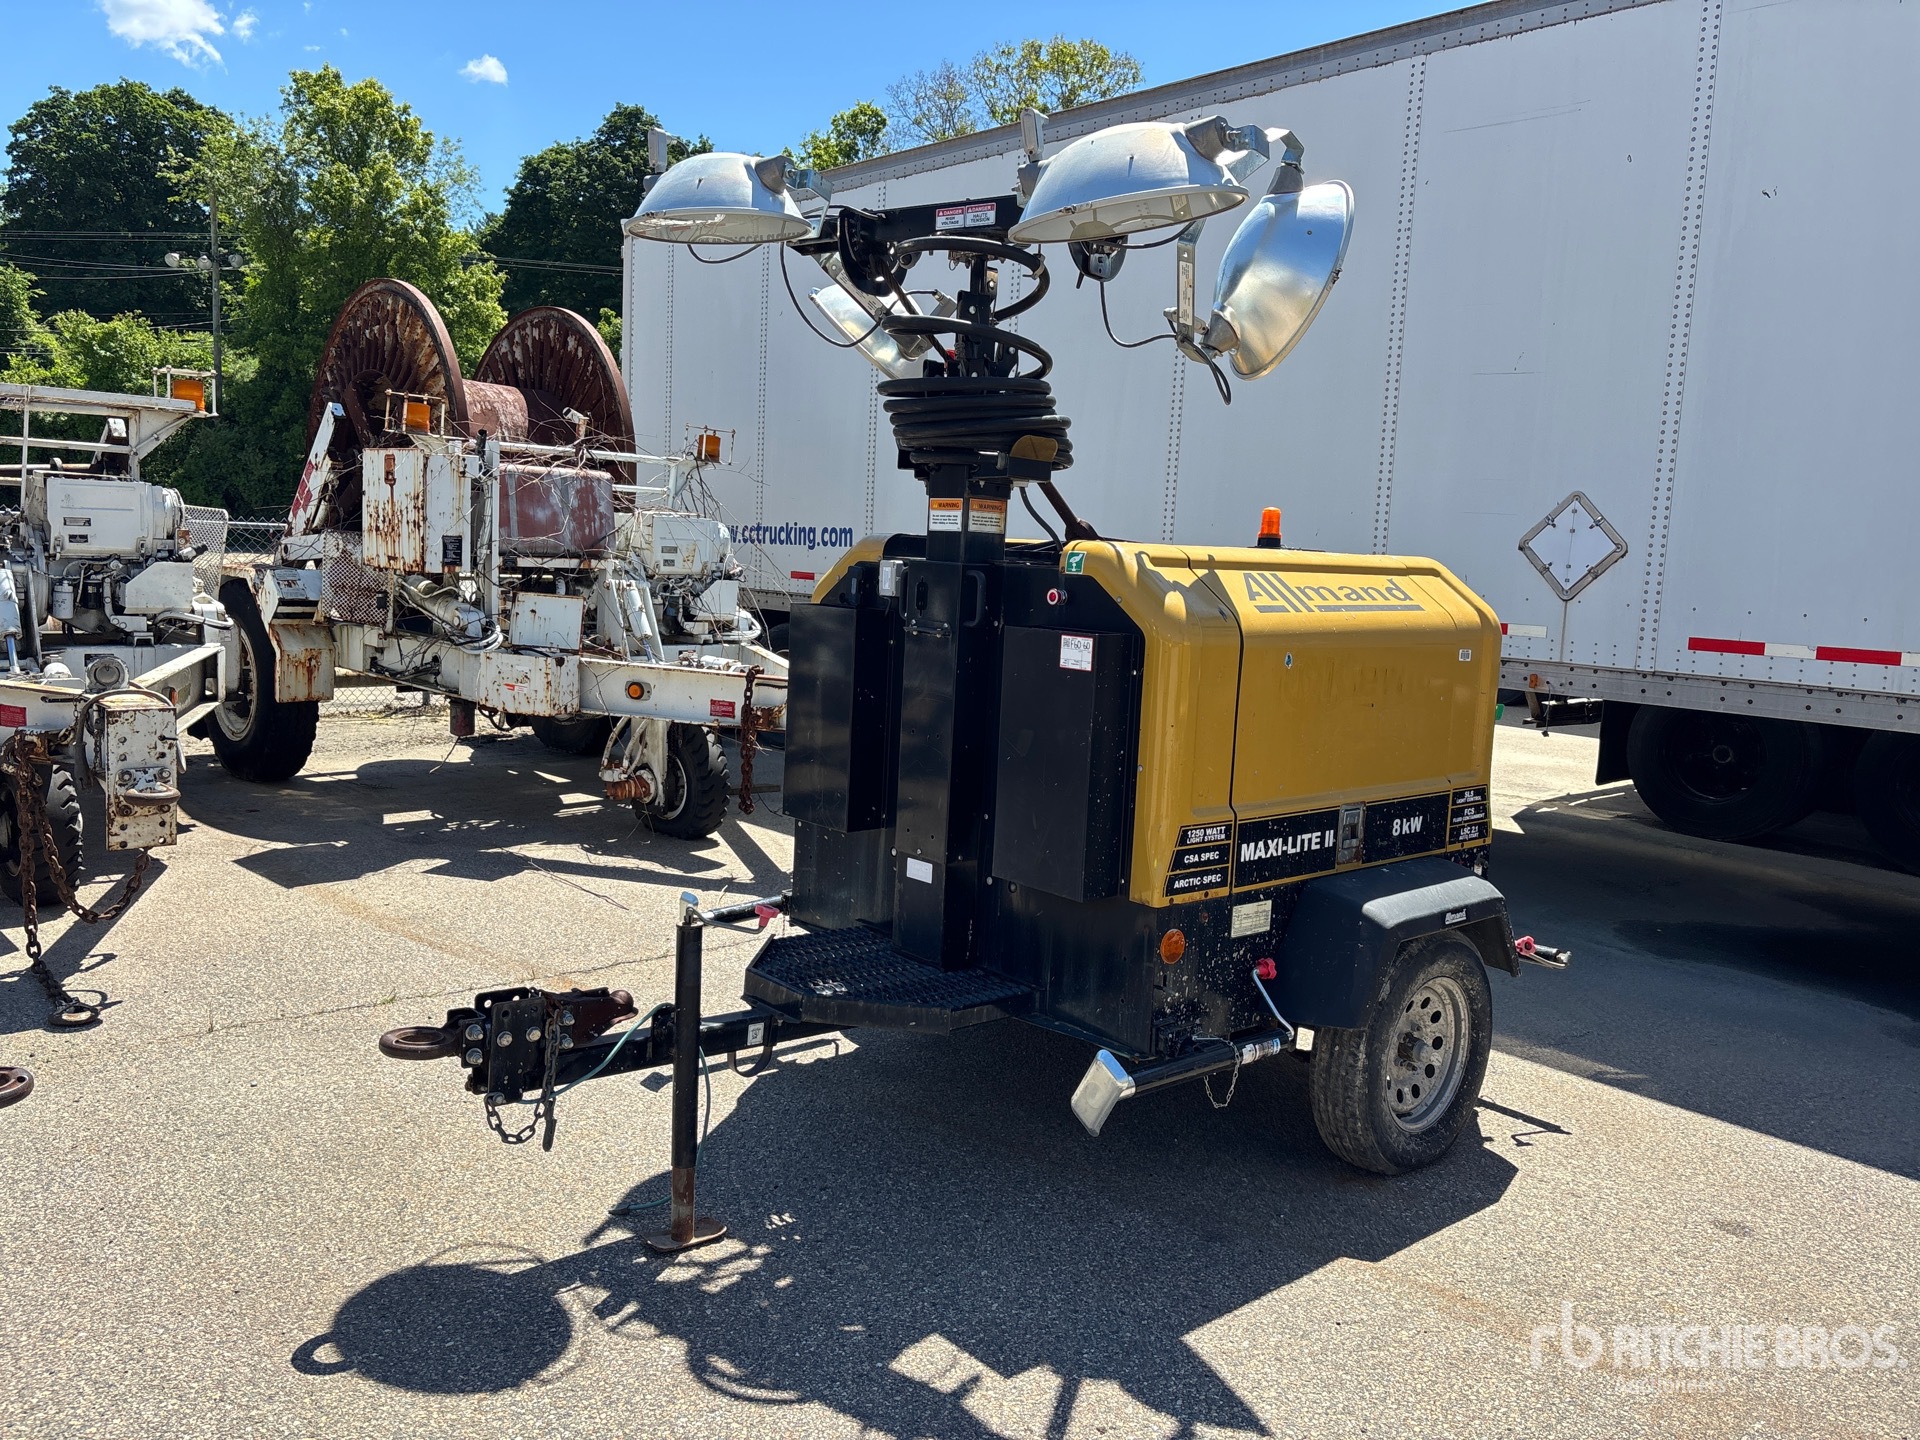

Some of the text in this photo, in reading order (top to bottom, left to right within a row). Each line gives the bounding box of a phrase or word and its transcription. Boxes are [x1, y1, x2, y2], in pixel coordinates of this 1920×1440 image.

[979, 503, 1003, 511] WARNING
[1242, 572, 1415, 613] Allmand
[1187, 826, 1226, 838] 1250 WATT
[1204, 834, 1226, 842] SYSTEM
[1240, 831, 1322, 863] MAXI-LITE
[1184, 851, 1220, 864] CSA SPEC
[1174, 873, 1222, 889] ARCTIC SPEC
